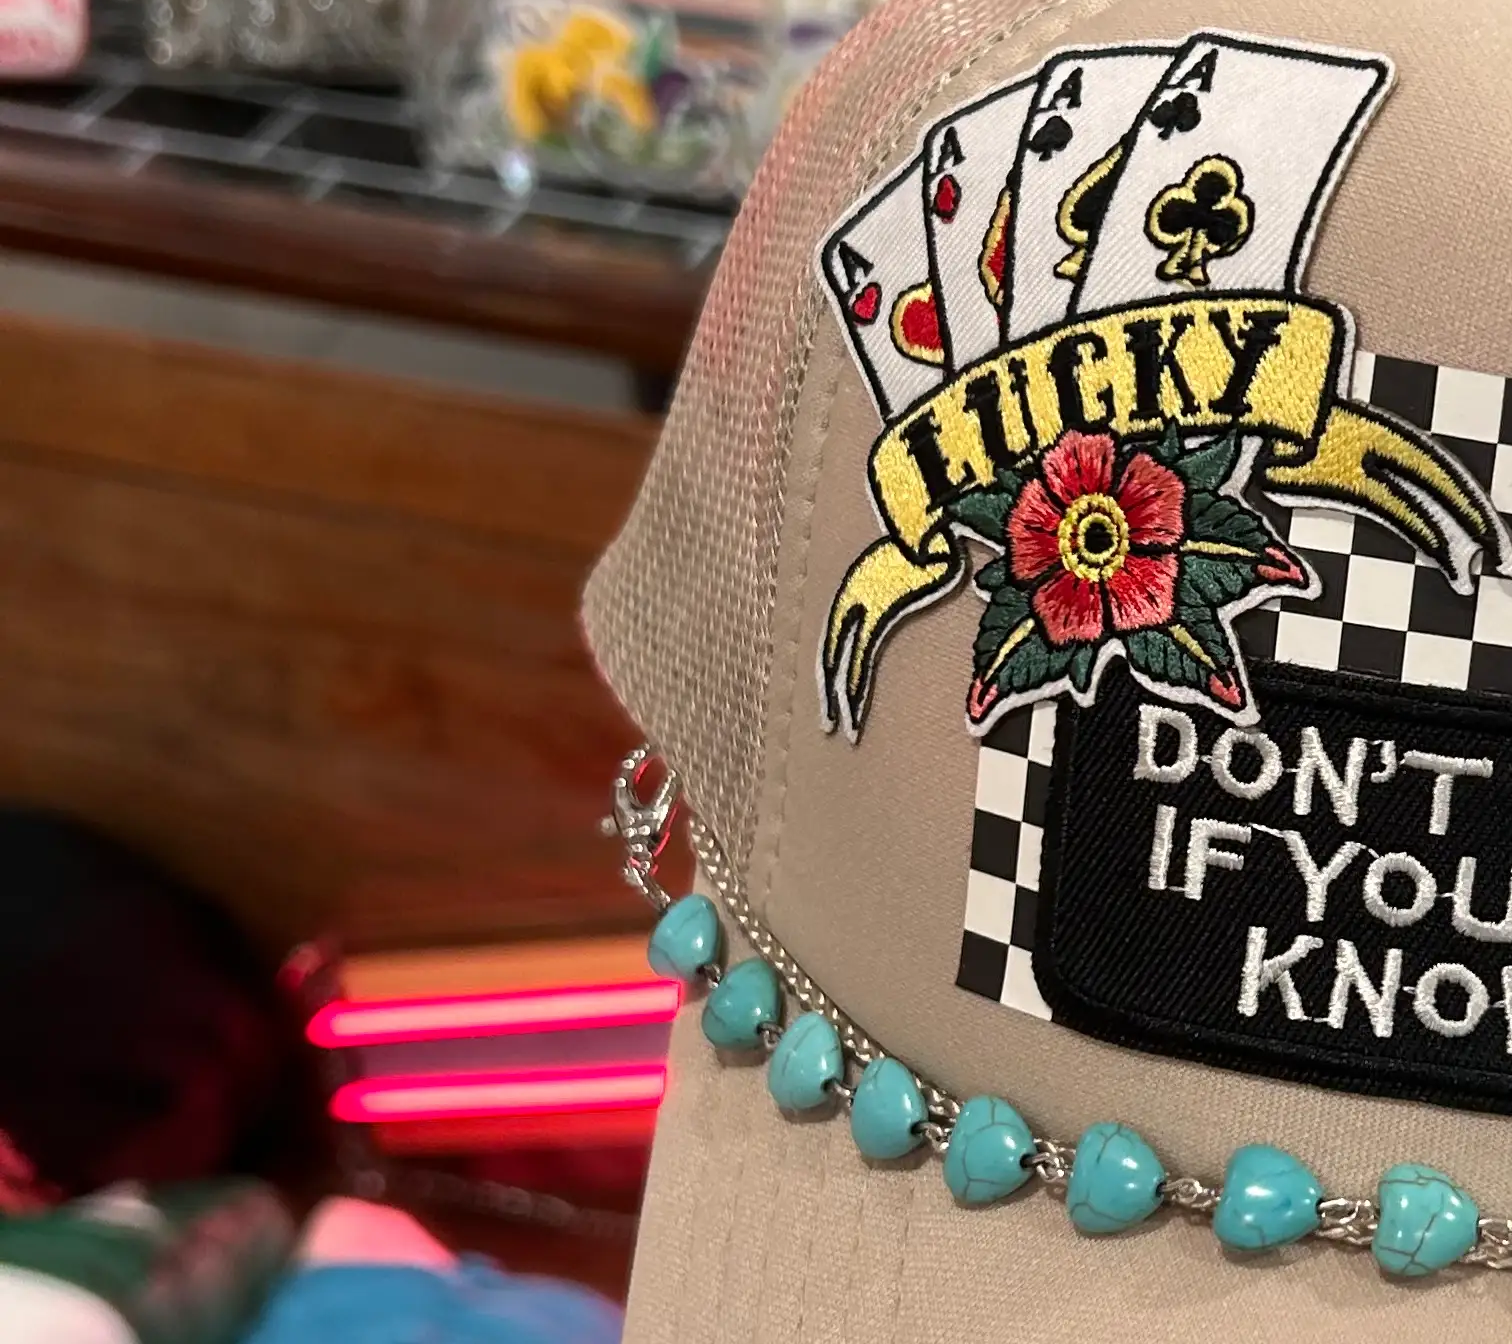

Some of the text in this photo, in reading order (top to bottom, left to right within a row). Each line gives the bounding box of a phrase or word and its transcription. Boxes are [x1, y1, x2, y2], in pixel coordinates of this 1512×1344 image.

[1045, 65, 1084, 111] A
[1173, 47, 1220, 93] A
[935, 125, 967, 176] A
[837, 241, 874, 293] A
[903, 310, 1292, 512] LUCKY
[1136, 704, 1493, 836] DON'T
[1148, 805, 1253, 901] IF
